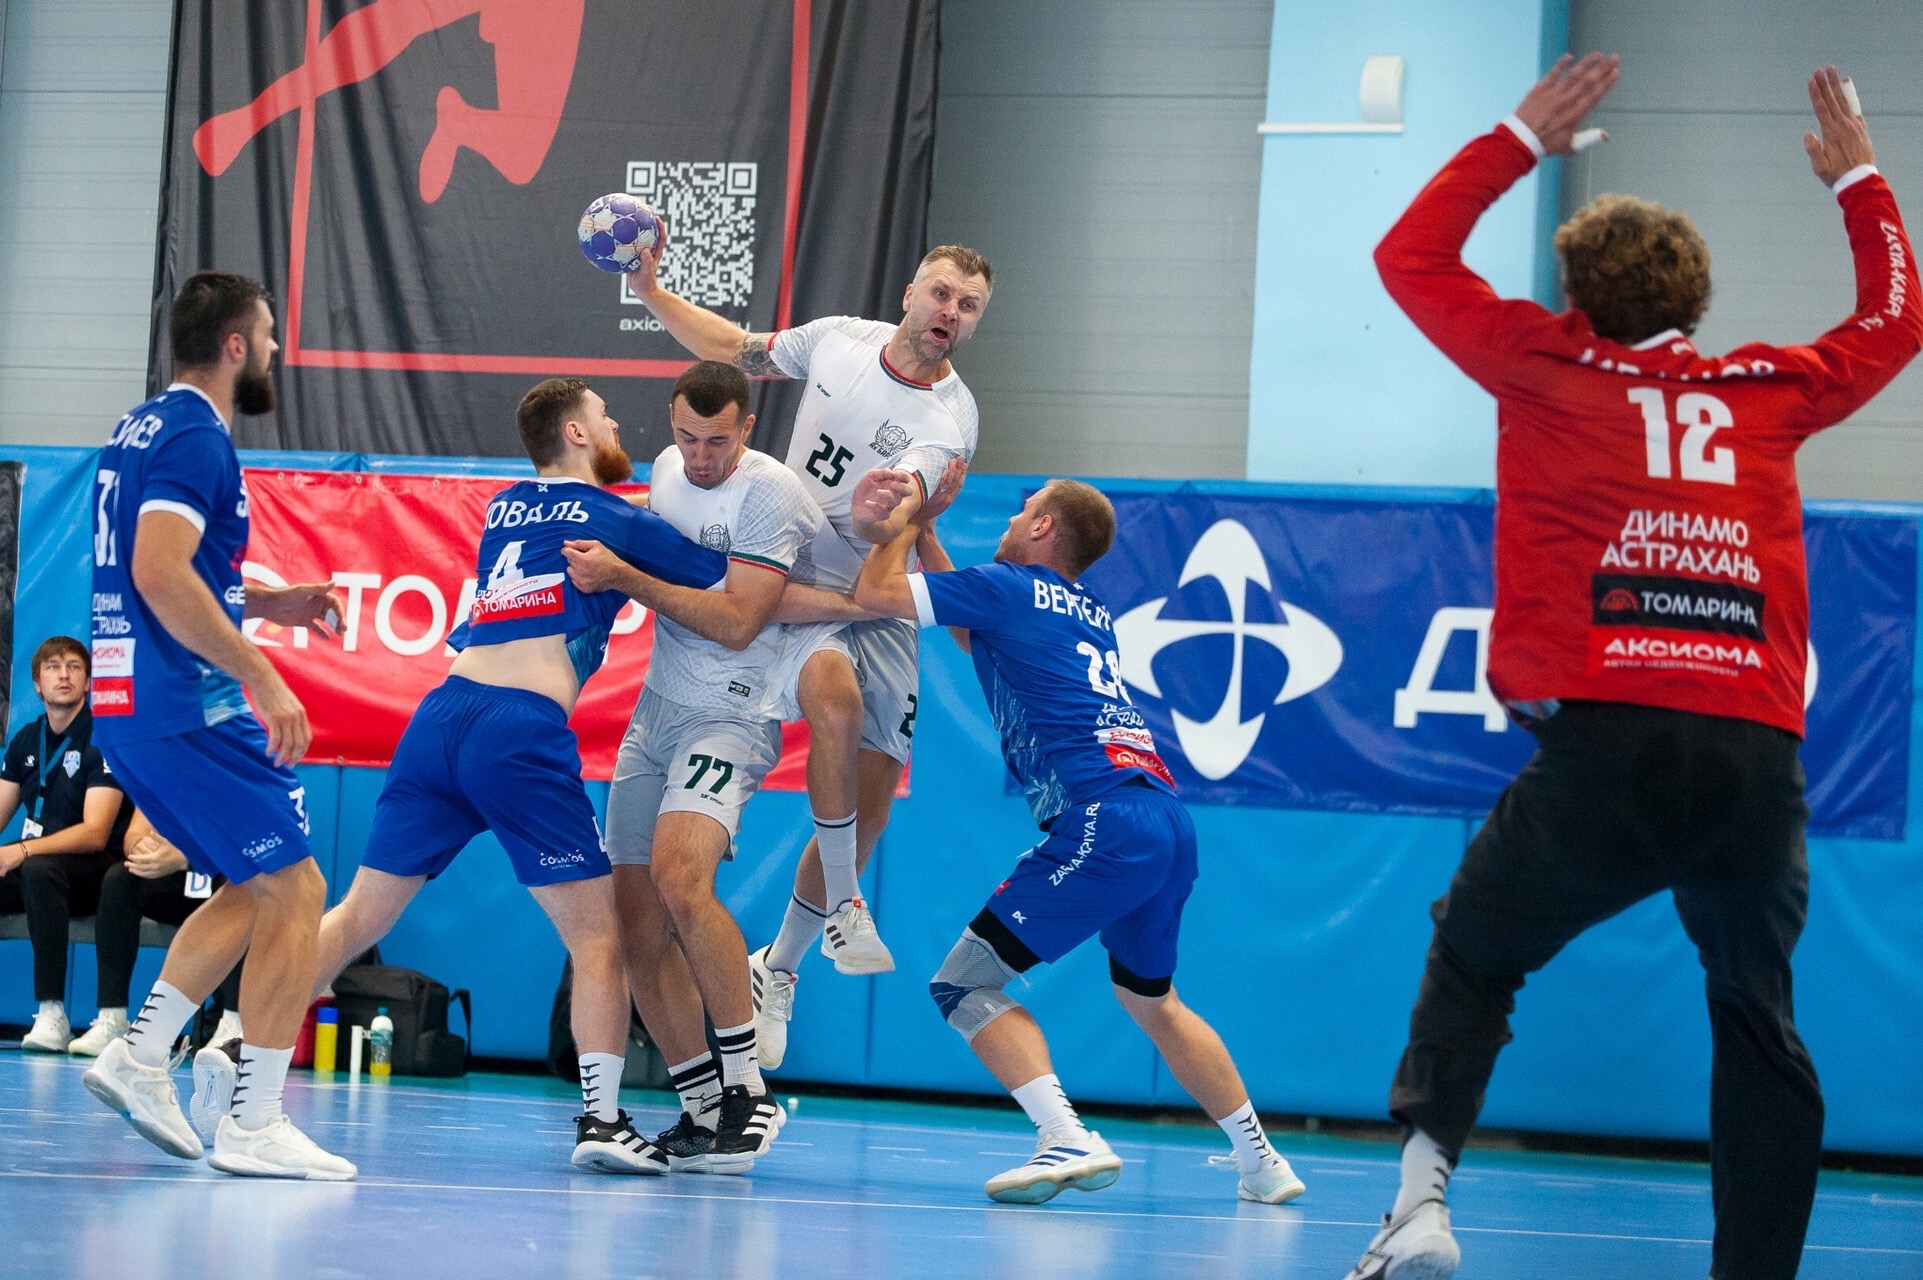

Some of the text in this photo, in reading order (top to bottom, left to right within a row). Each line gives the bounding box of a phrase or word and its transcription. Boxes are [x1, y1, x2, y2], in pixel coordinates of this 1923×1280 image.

[1628, 387, 1735, 485] 12
[805, 432, 855, 488] 25
[484, 500, 589, 530] ОВАЛЬ
[1620, 509, 1749, 548] ДИНАМО
[1600, 541, 1761, 584] АСТРАХАНЬ
[484, 591, 557, 614] ТОМАРИНА
[1640, 590, 1758, 627] ТОМАРИНА
[1604, 638, 1762, 669] АКСИОМА
[899, 693, 918, 740] 2
[683, 753, 734, 795] 77
